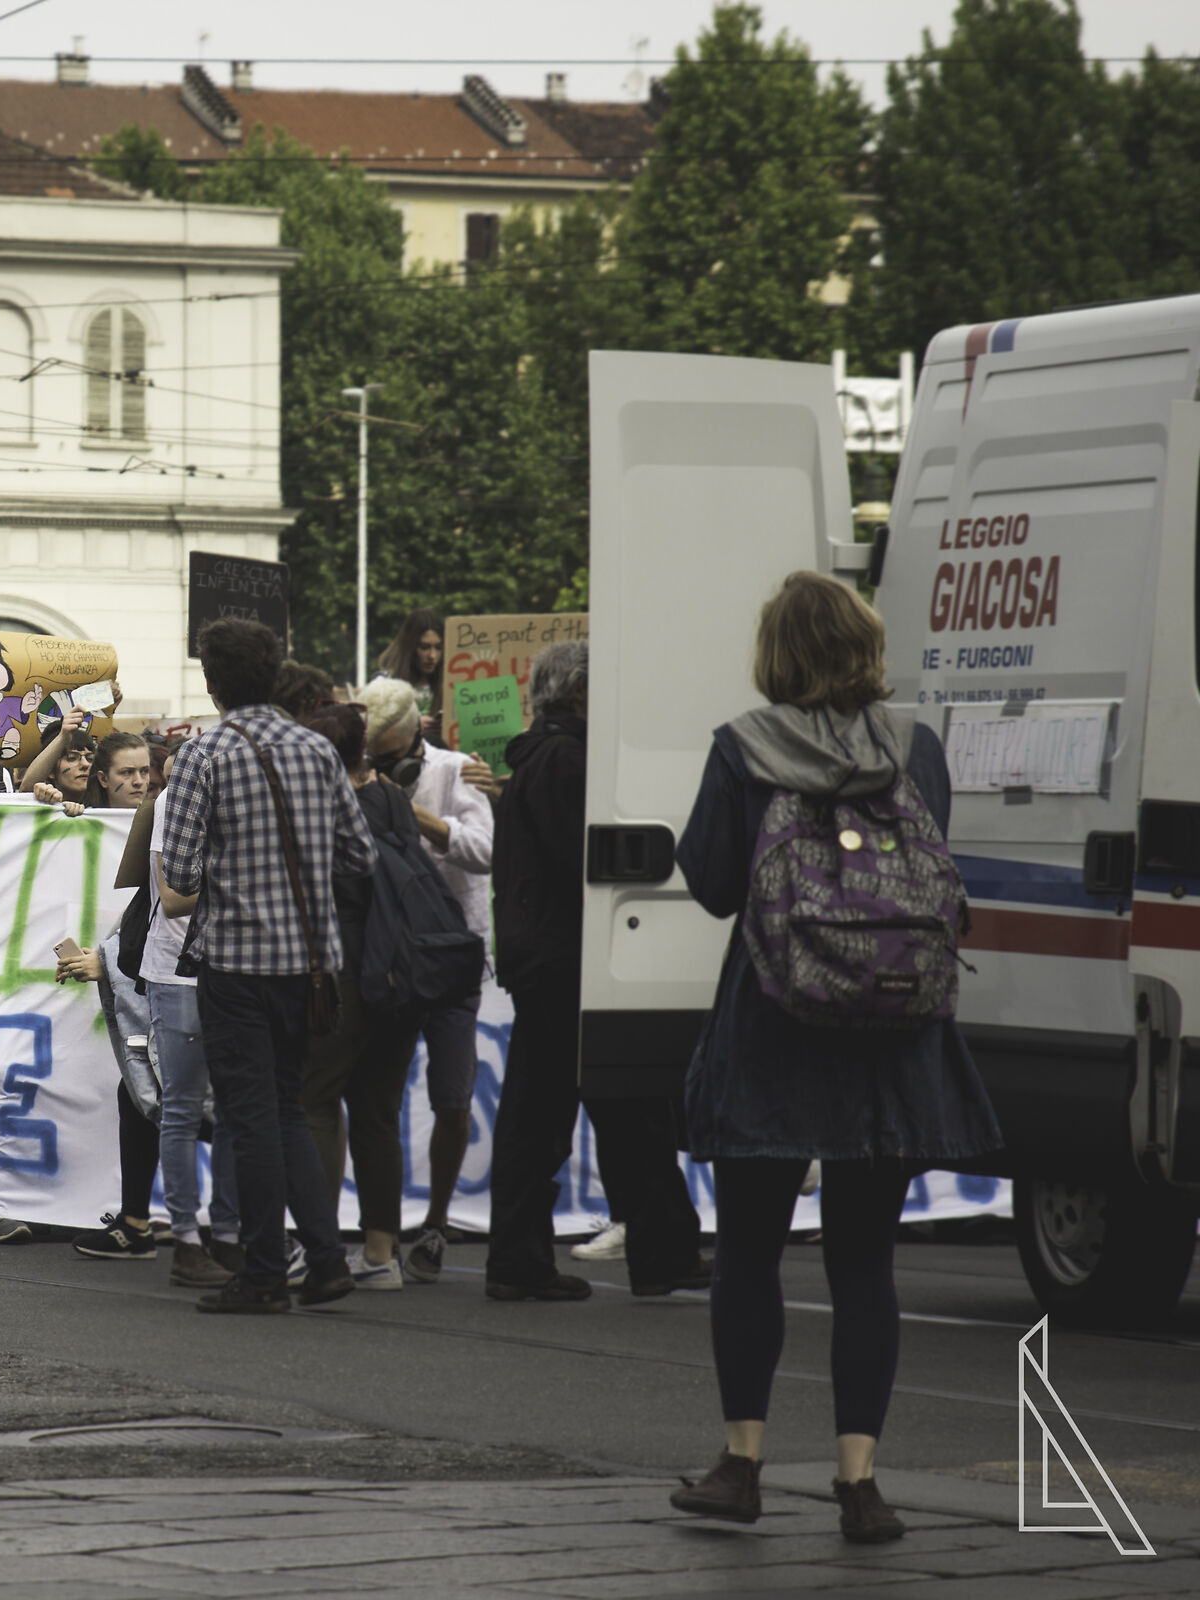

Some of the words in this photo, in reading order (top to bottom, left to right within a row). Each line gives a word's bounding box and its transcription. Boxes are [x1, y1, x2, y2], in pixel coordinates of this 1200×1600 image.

[938, 513, 1030, 550] LEGGIO
[929, 554, 1061, 633] GIACOSA
[456, 622, 492, 649] Be
[497, 620, 537, 655] part
[540, 618, 562, 643] of
[956, 644, 1034, 670] FURGONI
[459, 687, 477, 706] Se
